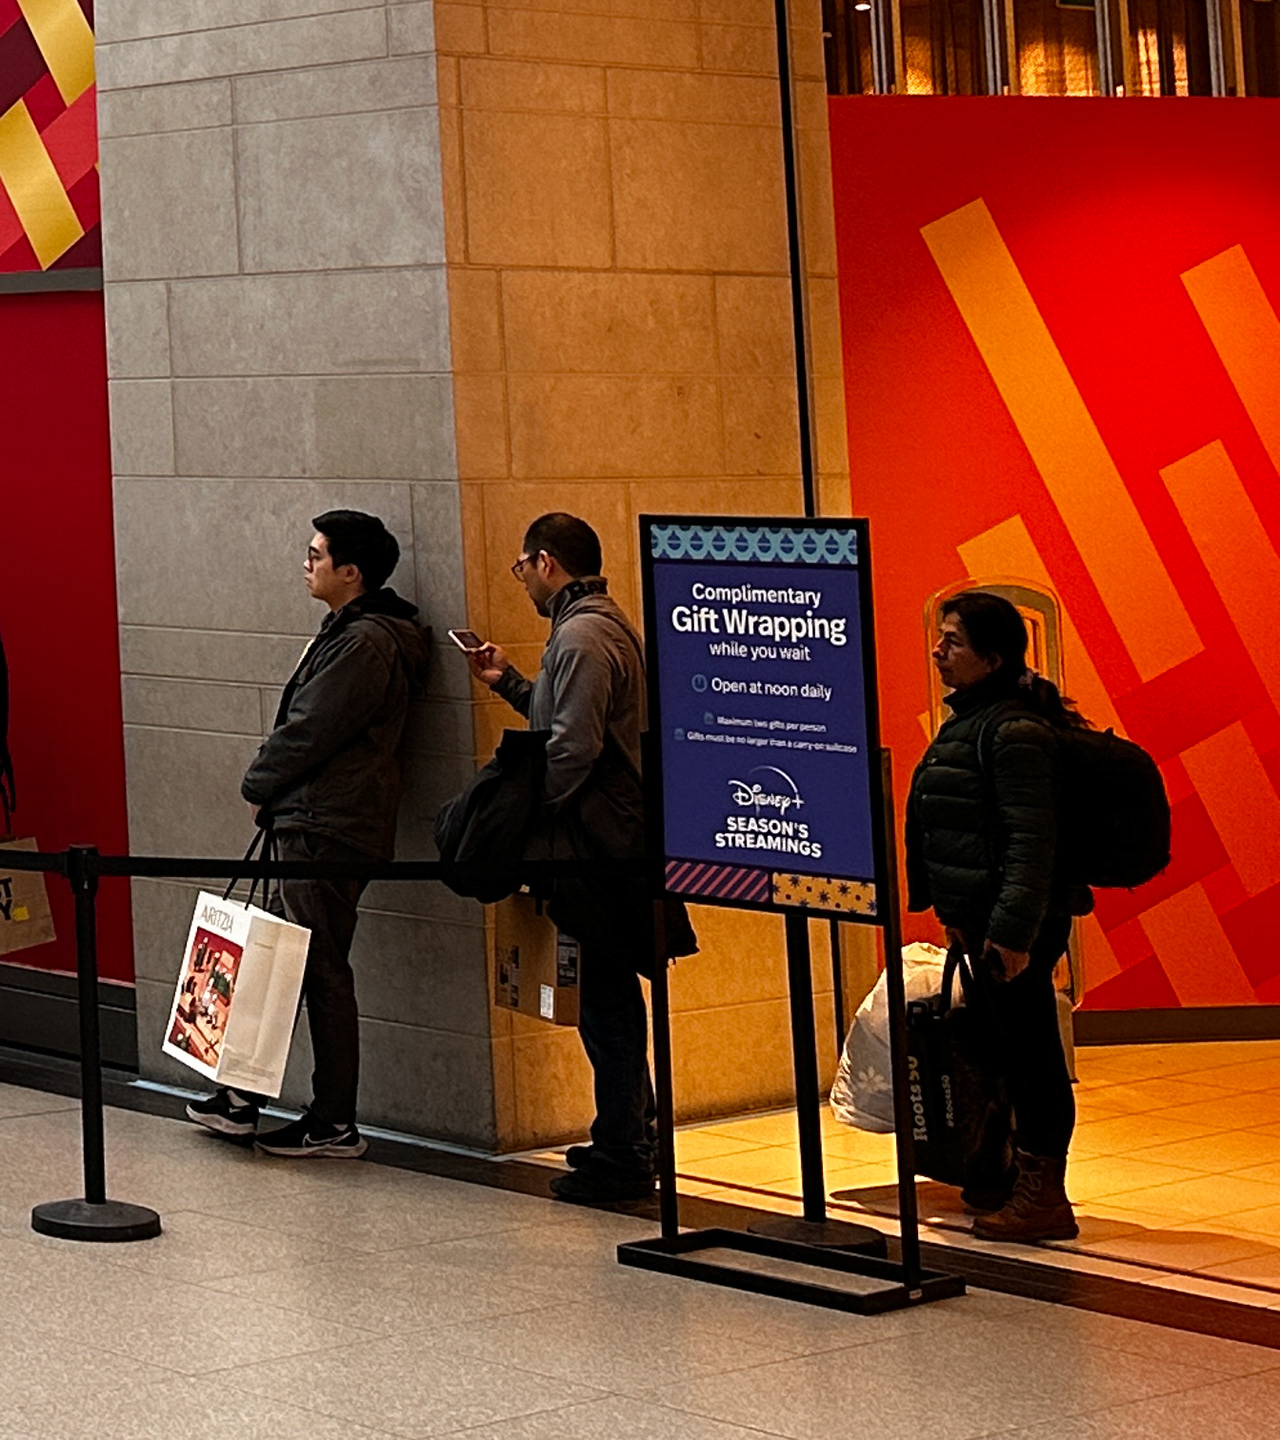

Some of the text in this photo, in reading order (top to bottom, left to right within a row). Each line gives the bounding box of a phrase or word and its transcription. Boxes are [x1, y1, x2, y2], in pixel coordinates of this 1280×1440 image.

[691, 583, 821, 609] Complimentary
[671, 605, 847, 646] Gift Wrapping
[709, 641, 811, 661] while you wait
[711, 677, 832, 701] Open at noon daily
[728, 780, 804, 815] Disney+
[726, 816, 809, 838] SEASON'S
[715, 832, 822, 858] STREAMINGS
